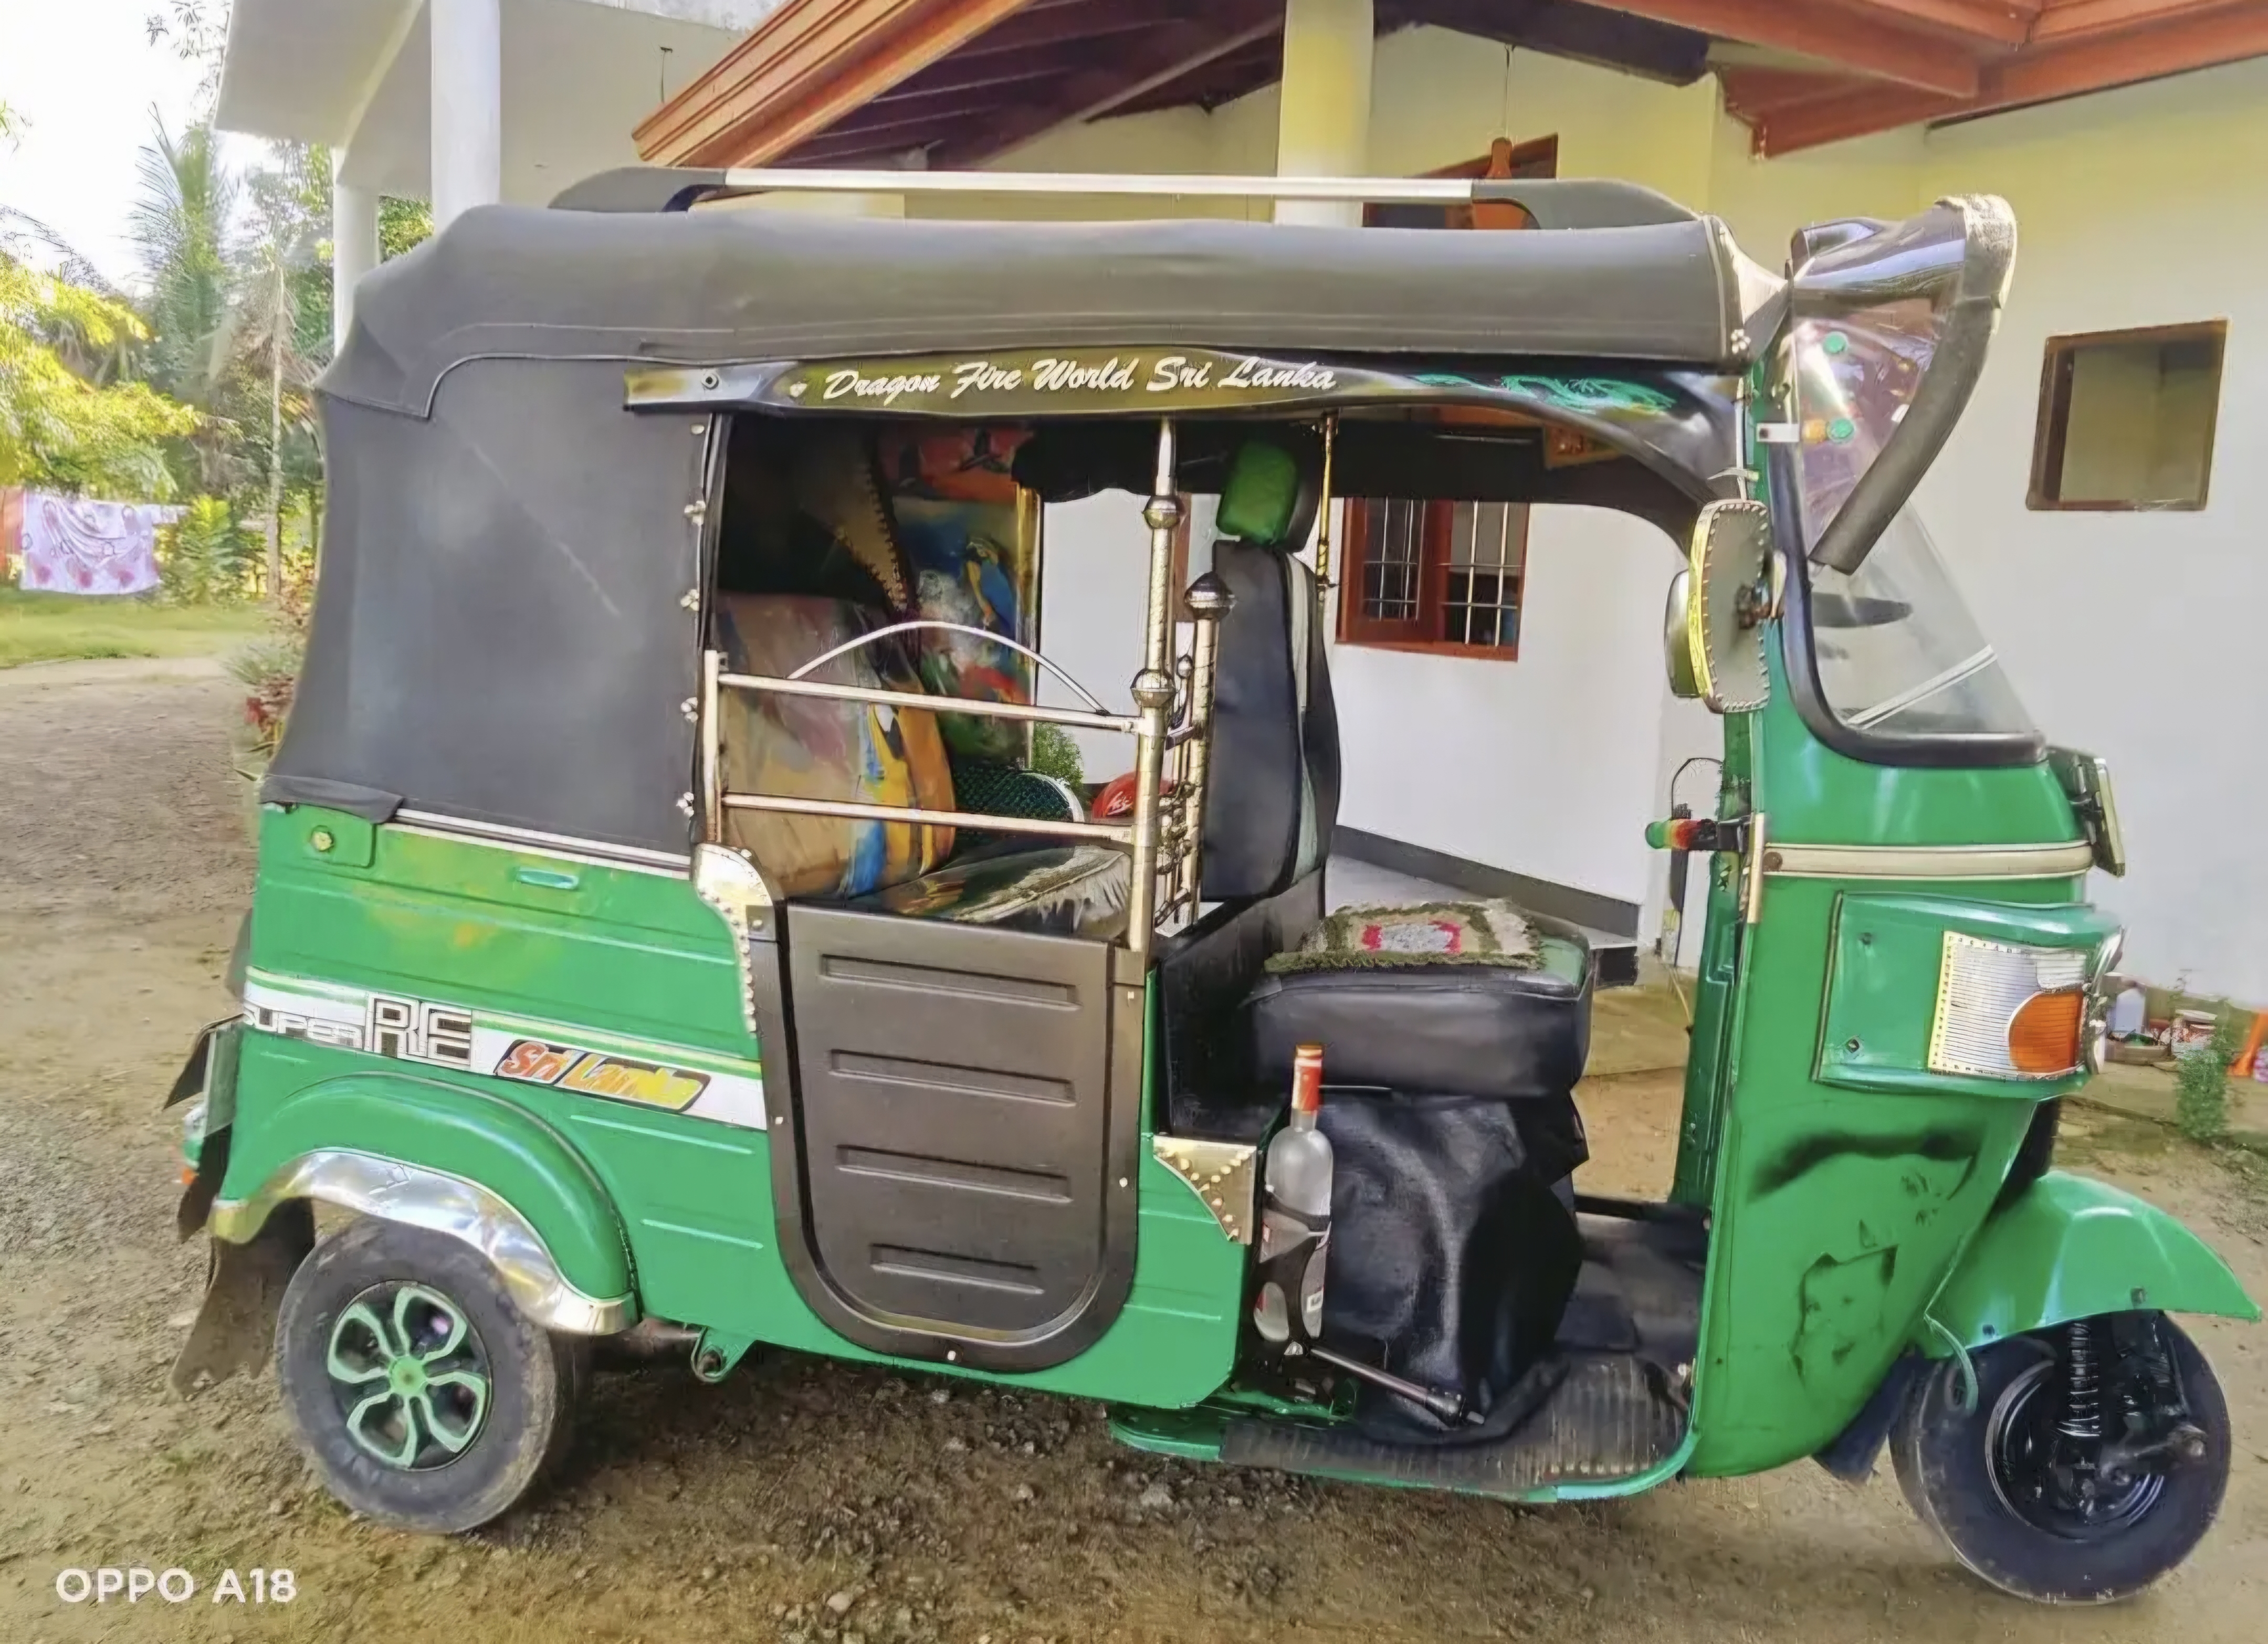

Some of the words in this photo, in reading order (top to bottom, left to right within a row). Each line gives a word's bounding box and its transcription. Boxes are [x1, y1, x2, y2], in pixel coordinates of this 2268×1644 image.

[823, 369, 941, 406] Dragon
[950, 361, 1022, 399] Fire
[1032, 356, 1140, 391] World
[1146, 356, 1213, 391] Sri
[1217, 356, 1337, 390] Lanka
